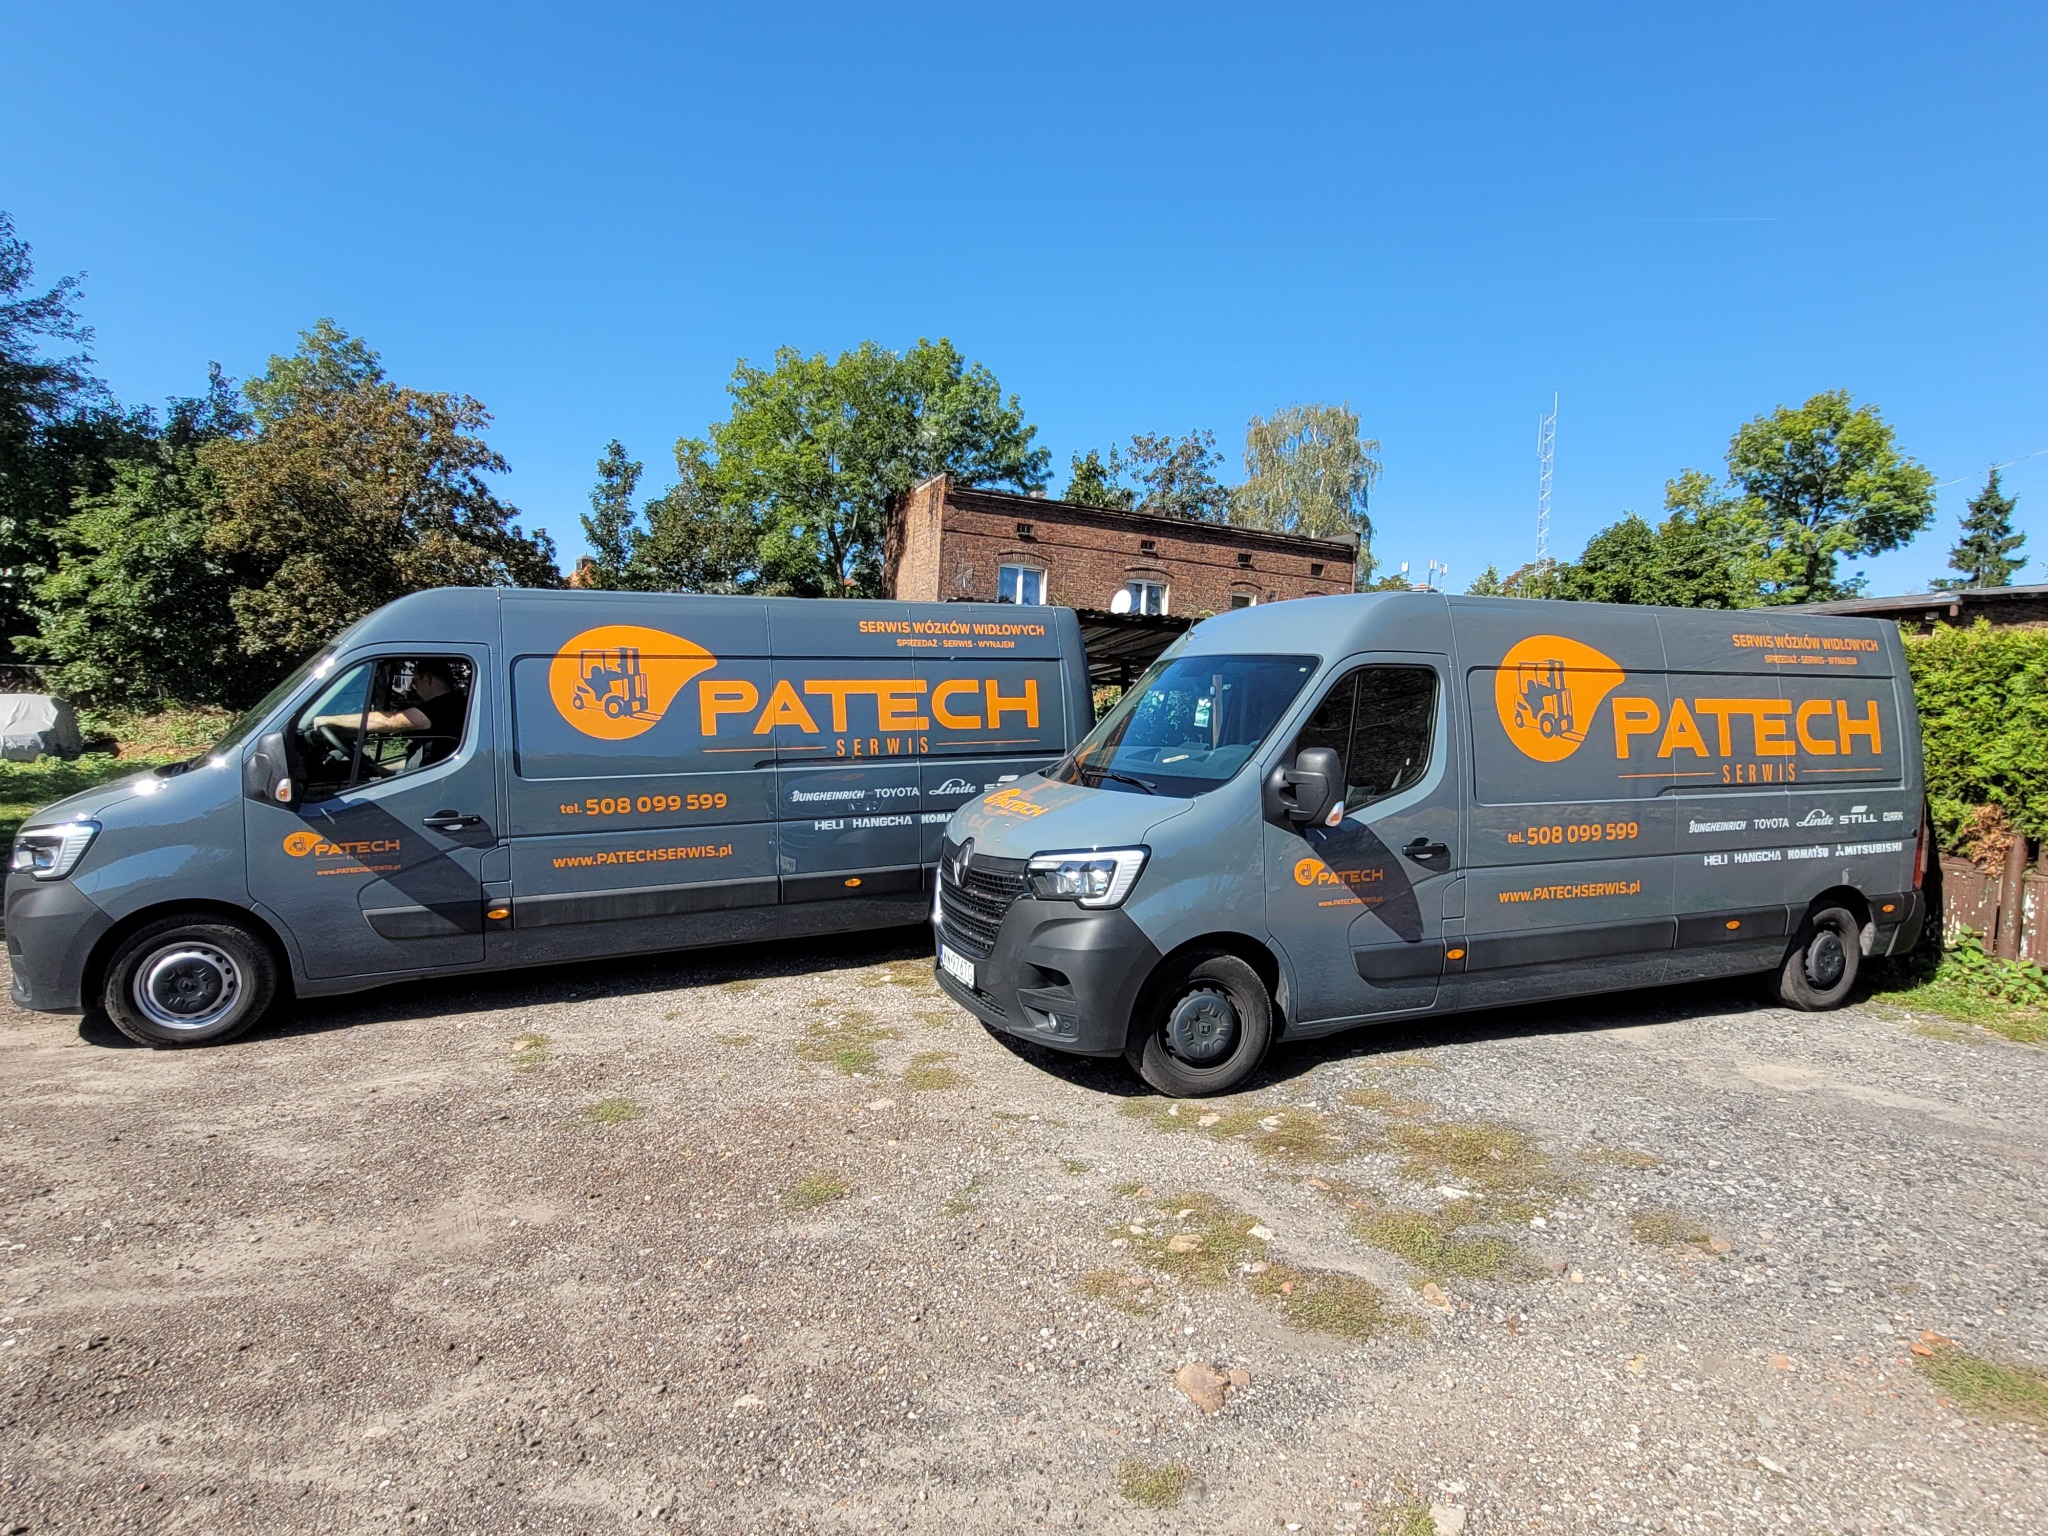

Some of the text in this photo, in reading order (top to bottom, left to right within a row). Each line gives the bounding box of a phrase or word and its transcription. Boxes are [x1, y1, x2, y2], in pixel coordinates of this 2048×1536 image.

[859, 619, 1045, 636] SERWIS WÓZKÓW WIDŁOWYCH
[896, 638, 1015, 649] SPRZEDAŻ SERWIS WYNAJEM
[1732, 633, 1879, 652] SERWIS WÓZKÓW WIDŁOWYCH
[698, 679, 1040, 736] PATECH
[1612, 698, 1881, 759] PATECH
[836, 736, 929, 757] SERWIS
[1722, 763, 1797, 783] SERWIS
[791, 789, 865, 802] JUNGHEINRICH
[874, 786, 920, 797] TOYOTA
[929, 778, 976, 796] Linde
[559, 792, 728, 817] tel. 508 099 599
[814, 819, 844, 831] HELI
[853, 815, 913, 828] HANGCHA
[1754, 818, 1790, 830] TOYOTA
[1796, 808, 1834, 828] Linde
[1839, 813, 1878, 825] STILL
[1507, 821, 1640, 846] tel. 508 099 599
[314, 839, 401, 857] PATECH
[552, 844, 733, 869] www.PATECHSERWIS.pl
[1703, 841, 1903, 866] HELI HANGCHA KOMATSU MITSUBISHI
[1317, 868, 1384, 886] PATECH
[1498, 879, 1642, 904] www.PATECHSERWIS.pl
